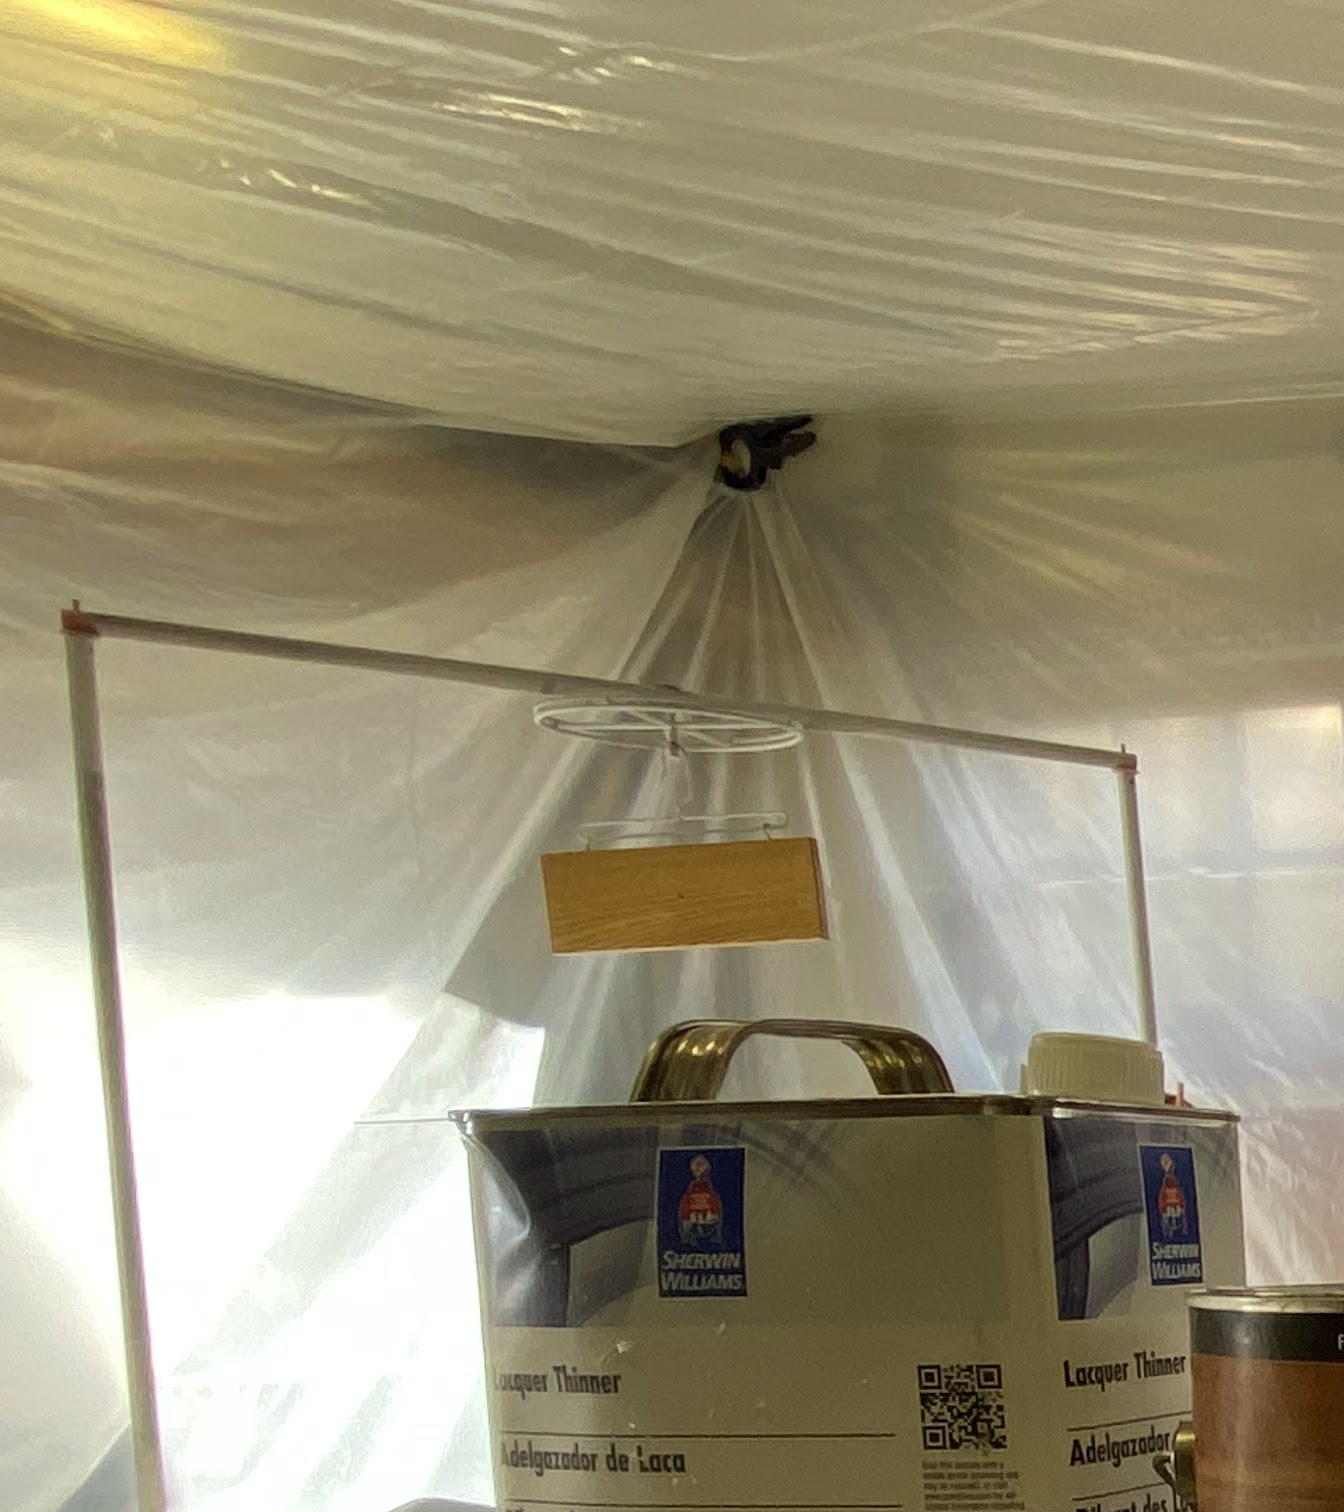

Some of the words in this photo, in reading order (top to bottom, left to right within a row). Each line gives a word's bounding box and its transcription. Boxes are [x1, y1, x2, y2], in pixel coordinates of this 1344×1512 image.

[662, 1251, 741, 1269] SHERWIN
[661, 1271, 742, 1291] WILLIAMS
[553, 1364, 622, 1394] Thinner
[1063, 1359, 1129, 1392] Lacquer
[1134, 1351, 1187, 1381] Thinner
[606, 1443, 629, 1472] de
[1069, 1425, 1171, 1467] Adelgazador
